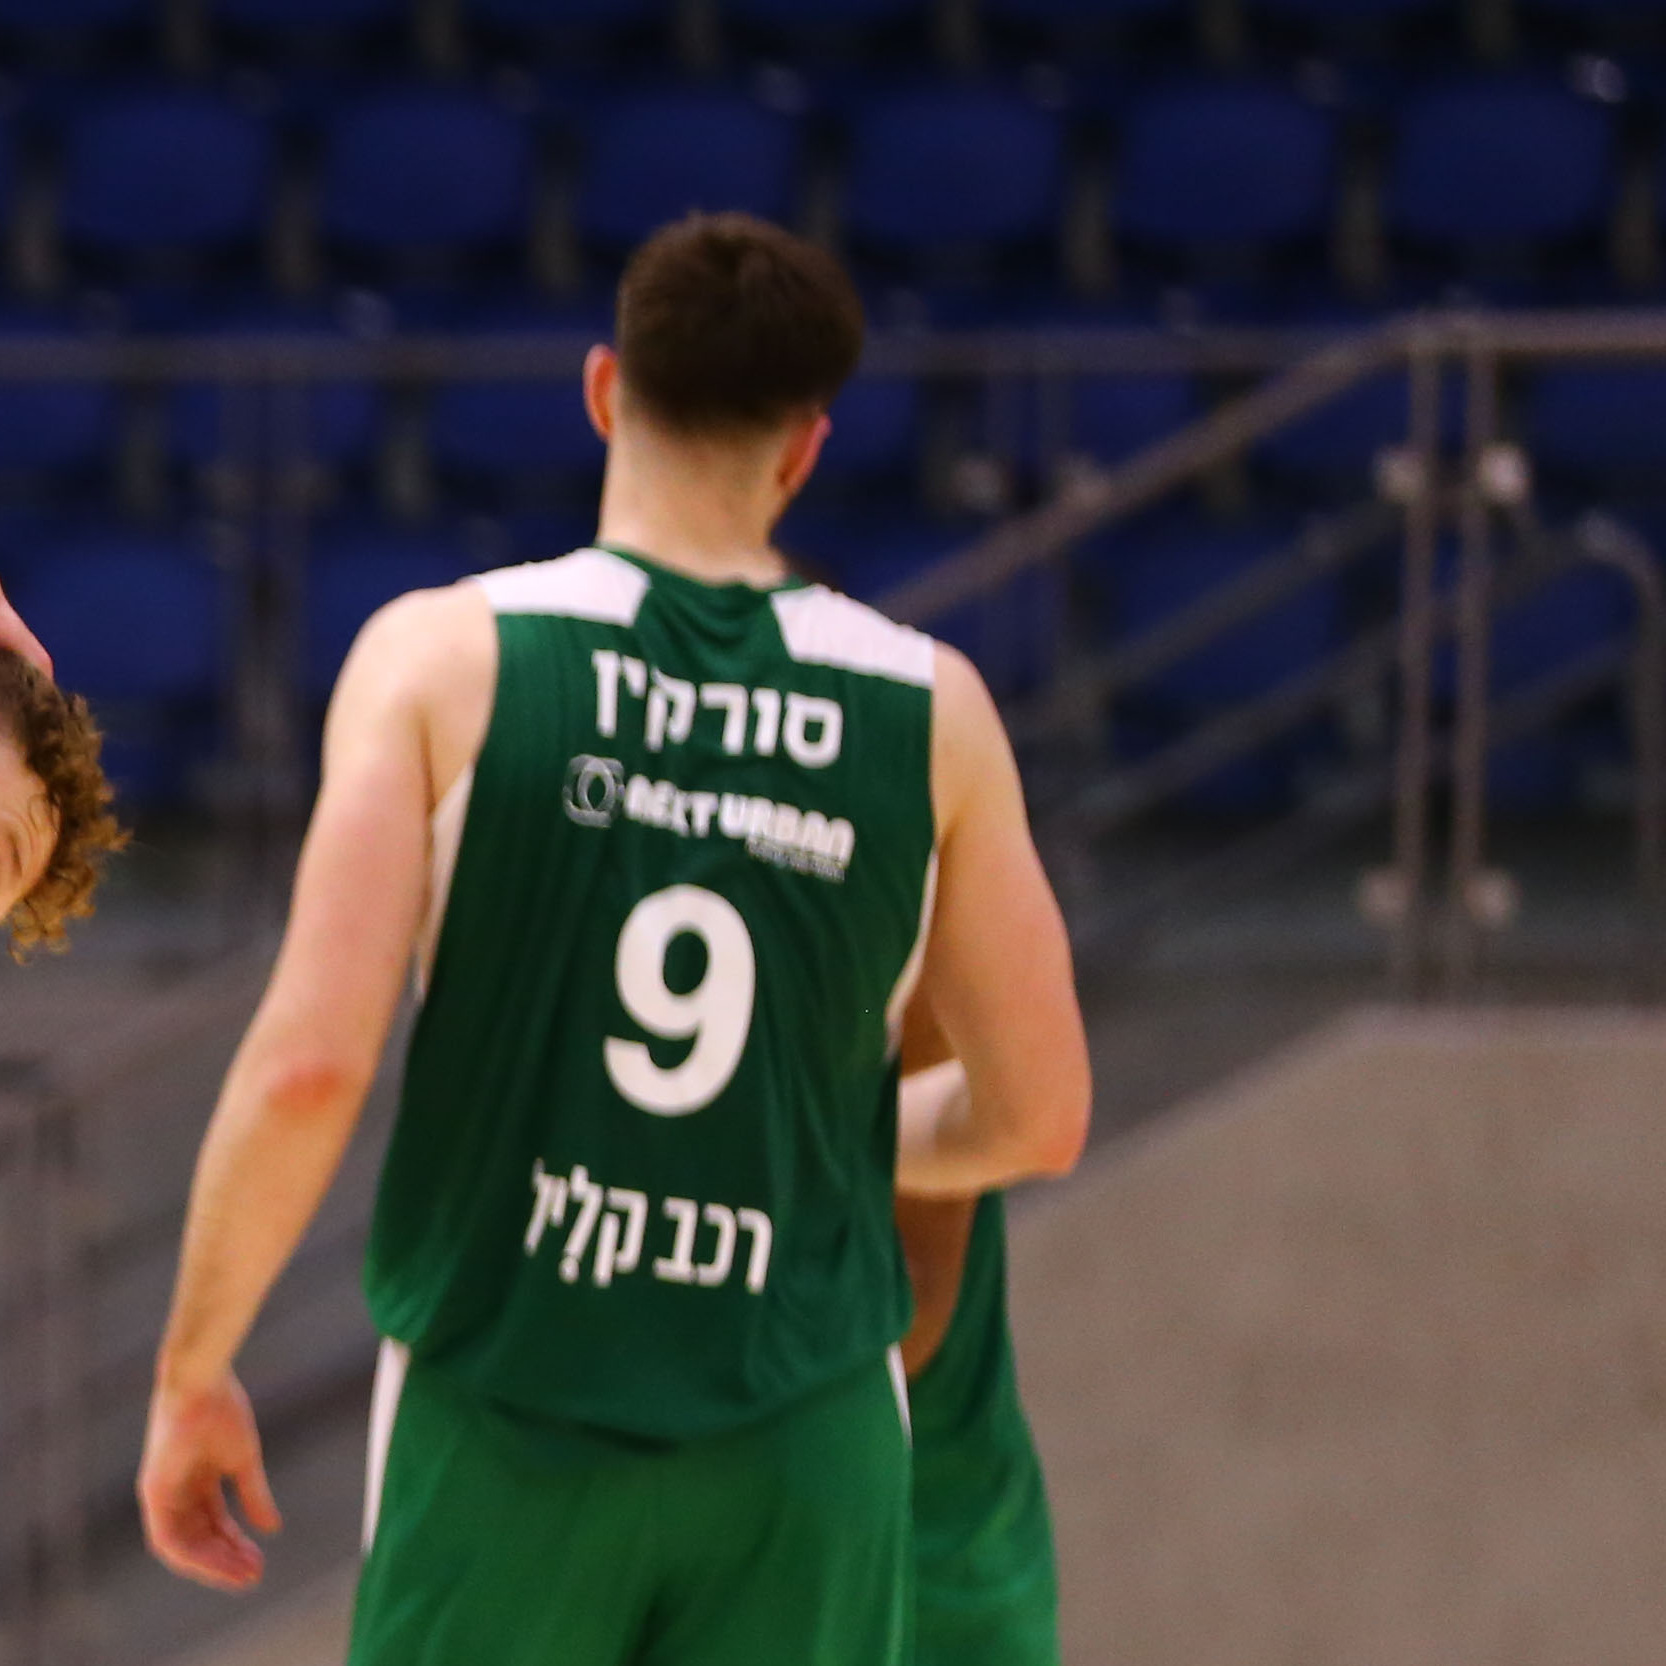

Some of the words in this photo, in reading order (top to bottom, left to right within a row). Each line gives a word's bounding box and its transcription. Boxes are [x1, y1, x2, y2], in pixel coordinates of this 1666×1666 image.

[591, 648, 844, 770] סורקין
[603, 883, 757, 1118] 9
[652, 1194, 774, 1296] רכב
